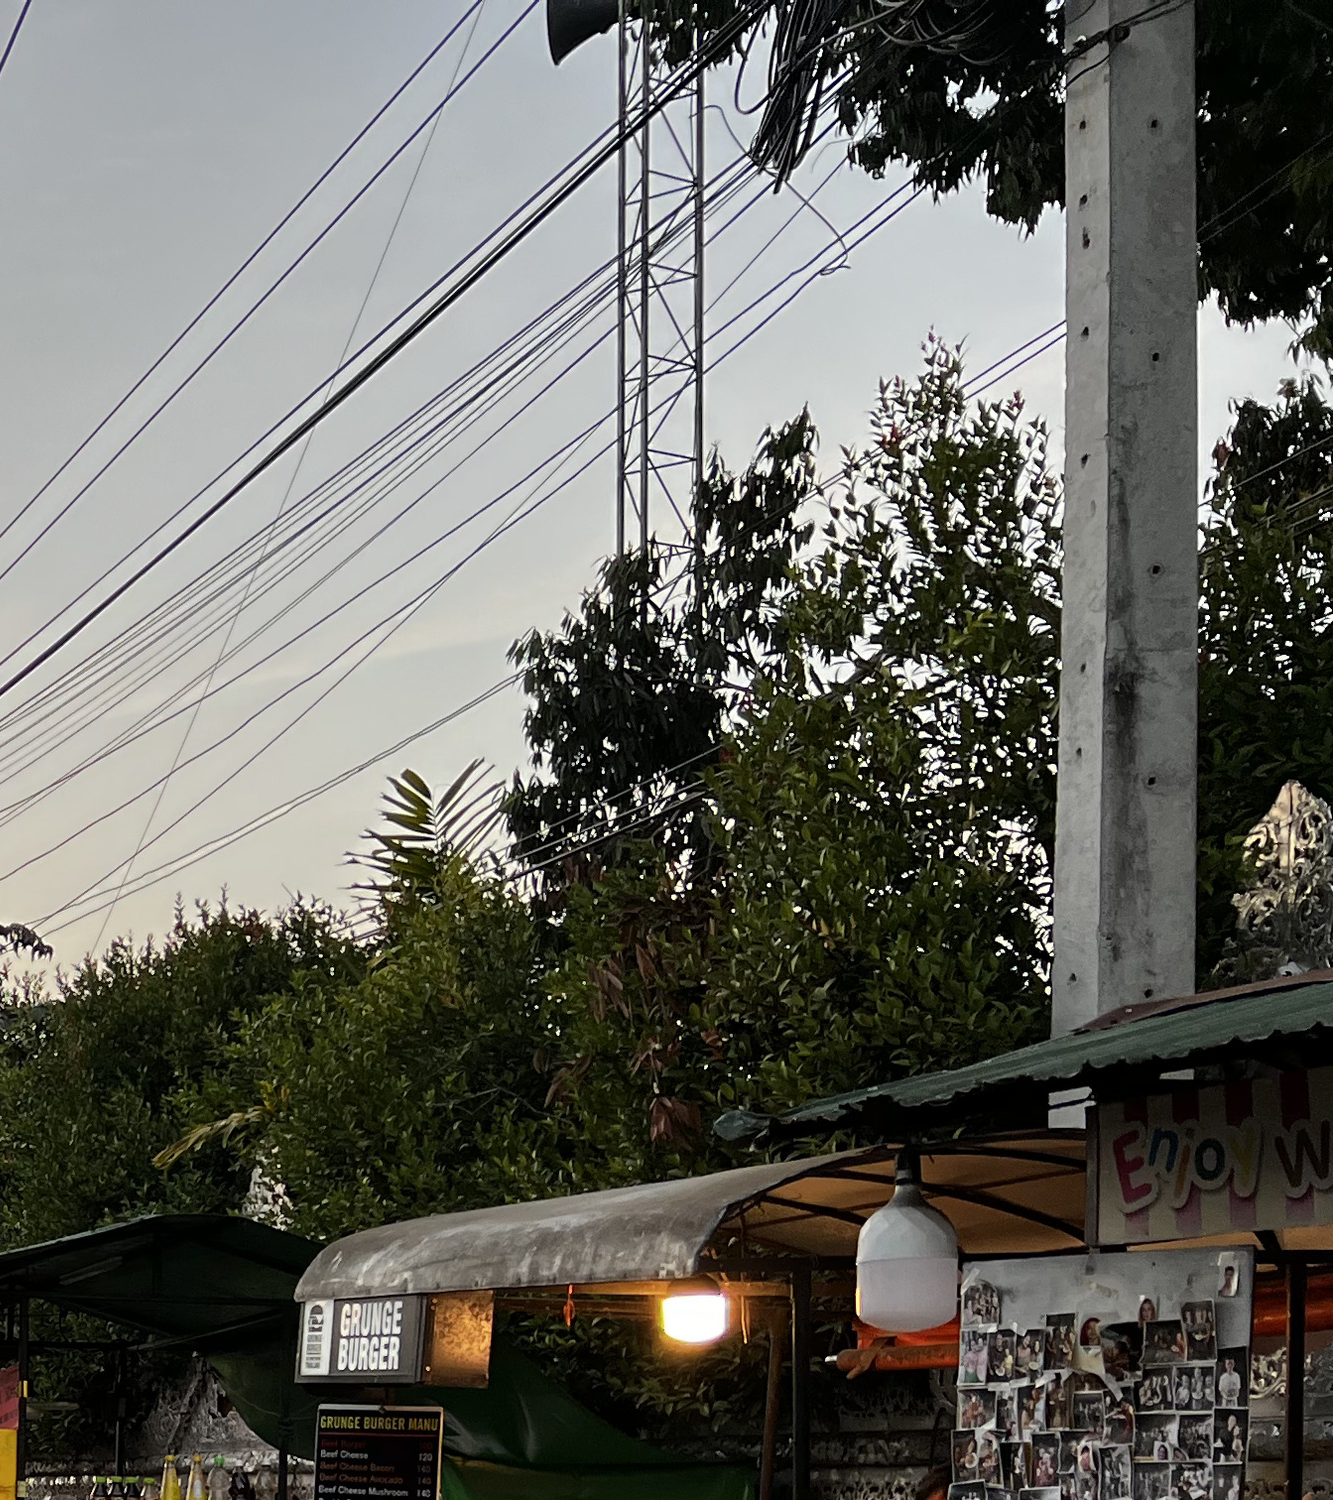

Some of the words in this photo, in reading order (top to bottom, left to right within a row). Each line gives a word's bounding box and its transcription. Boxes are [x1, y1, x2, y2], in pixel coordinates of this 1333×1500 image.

[1112, 1122, 1257, 1206] Enjoy
[340, 1301, 403, 1337] GRUNGE
[338, 1336, 400, 1371] BURGER
[320, 1416, 361, 1429] GRUNGE
[364, 1417, 405, 1430] BURGER
[408, 1418, 439, 1431] MANU
[320, 1449, 338, 1458] Beef
[340, 1450, 369, 1459] Cheese
[419, 1453, 433, 1461] 120
[318, 1485, 336, 1494] Beef
[338, 1486, 367, 1495] Cheese
[368, 1487, 409, 1497] Mushroom
